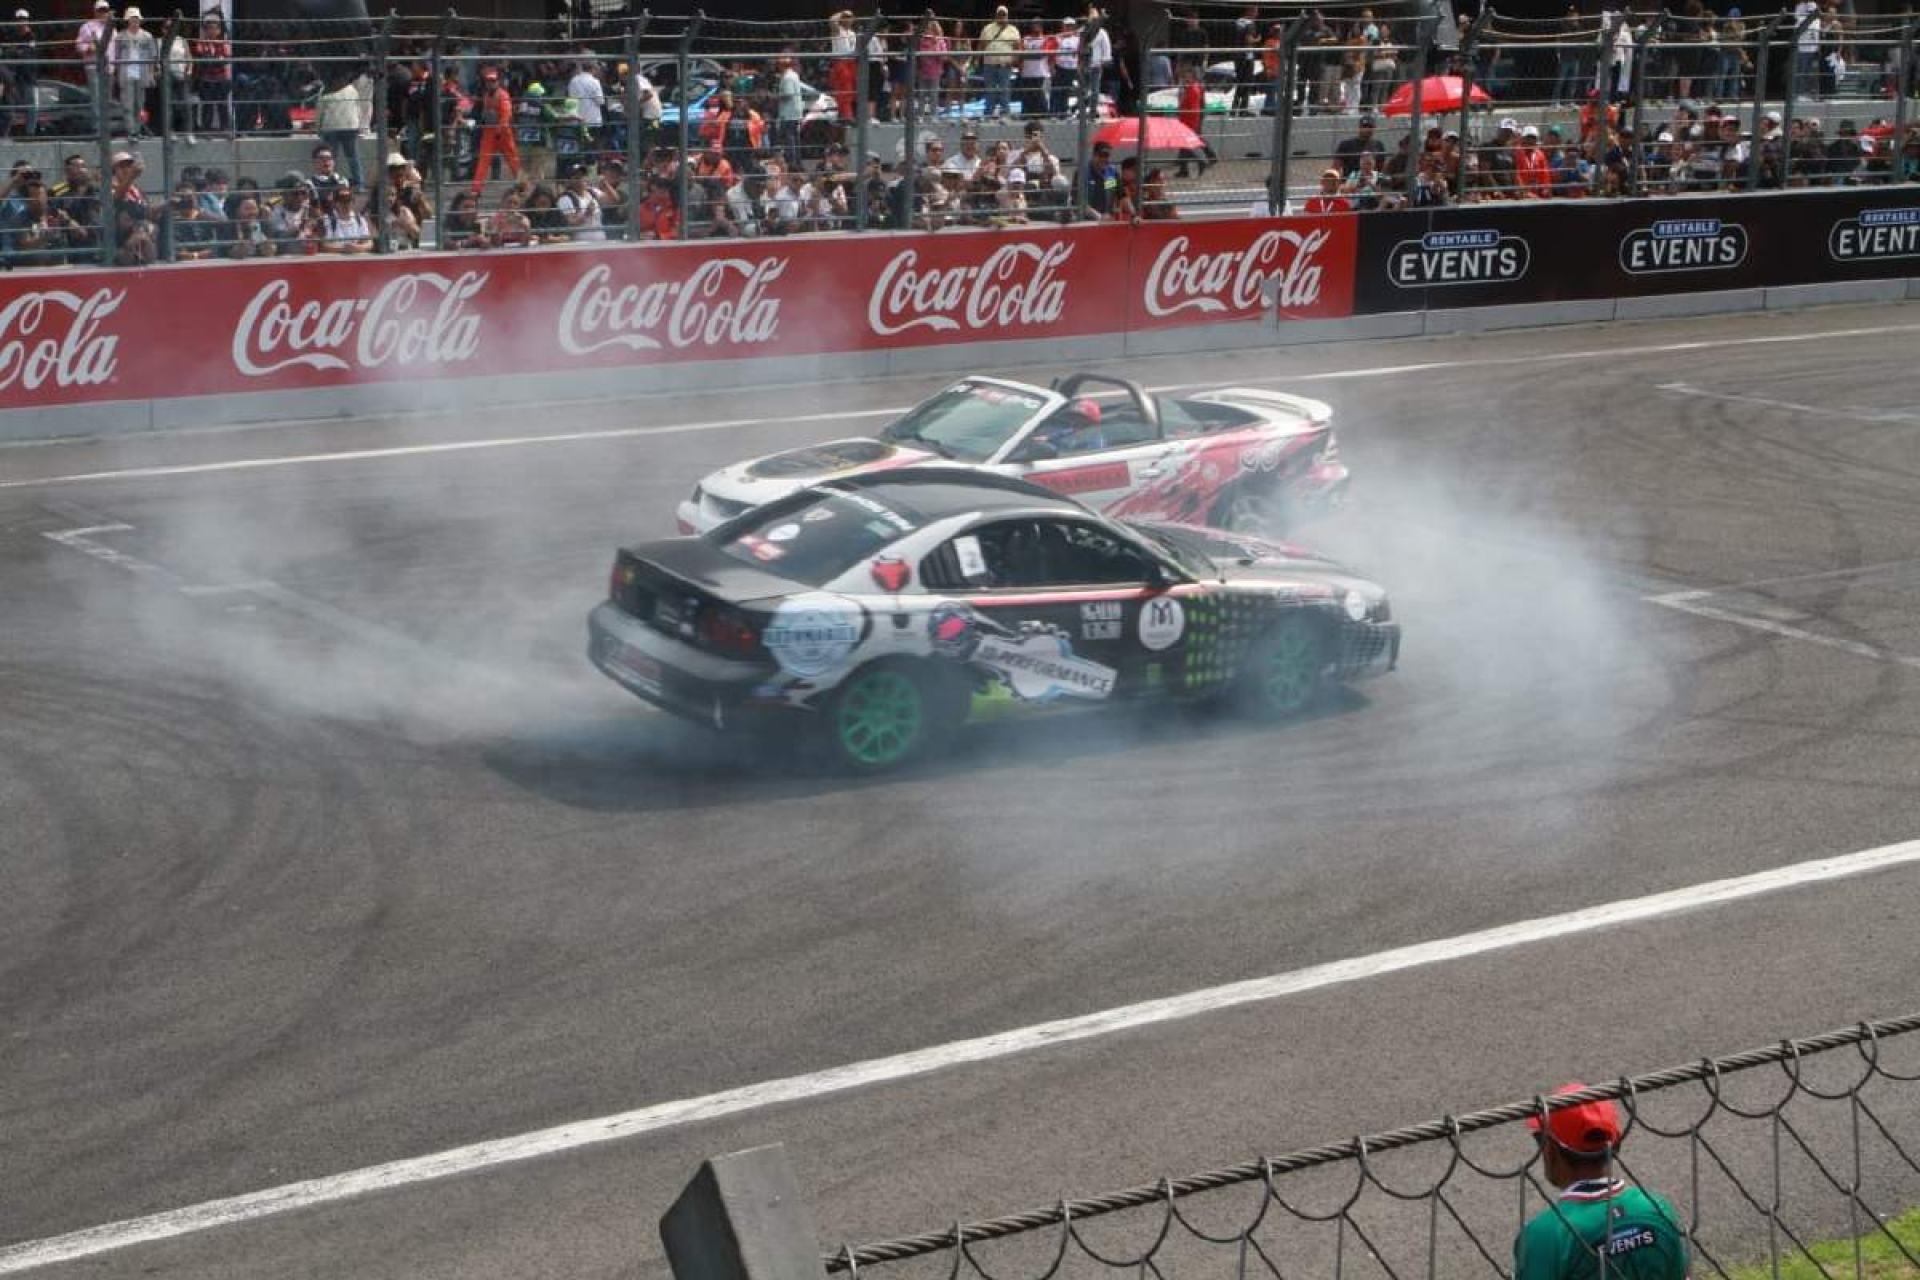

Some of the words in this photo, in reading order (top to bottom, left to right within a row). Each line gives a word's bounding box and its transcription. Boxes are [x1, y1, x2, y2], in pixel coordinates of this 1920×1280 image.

[1430, 233, 1492, 246] RENTABLE
[1658, 221, 1716, 235] RENTABLE
[1400, 247, 1517, 281] EVENTS
[1631, 236, 1737, 267] EVENTS
[868, 240, 1075, 335] Coca-Cola
[558, 256, 790, 355] Coca-Cola
[232, 271, 489, 377] Coca-Cola
